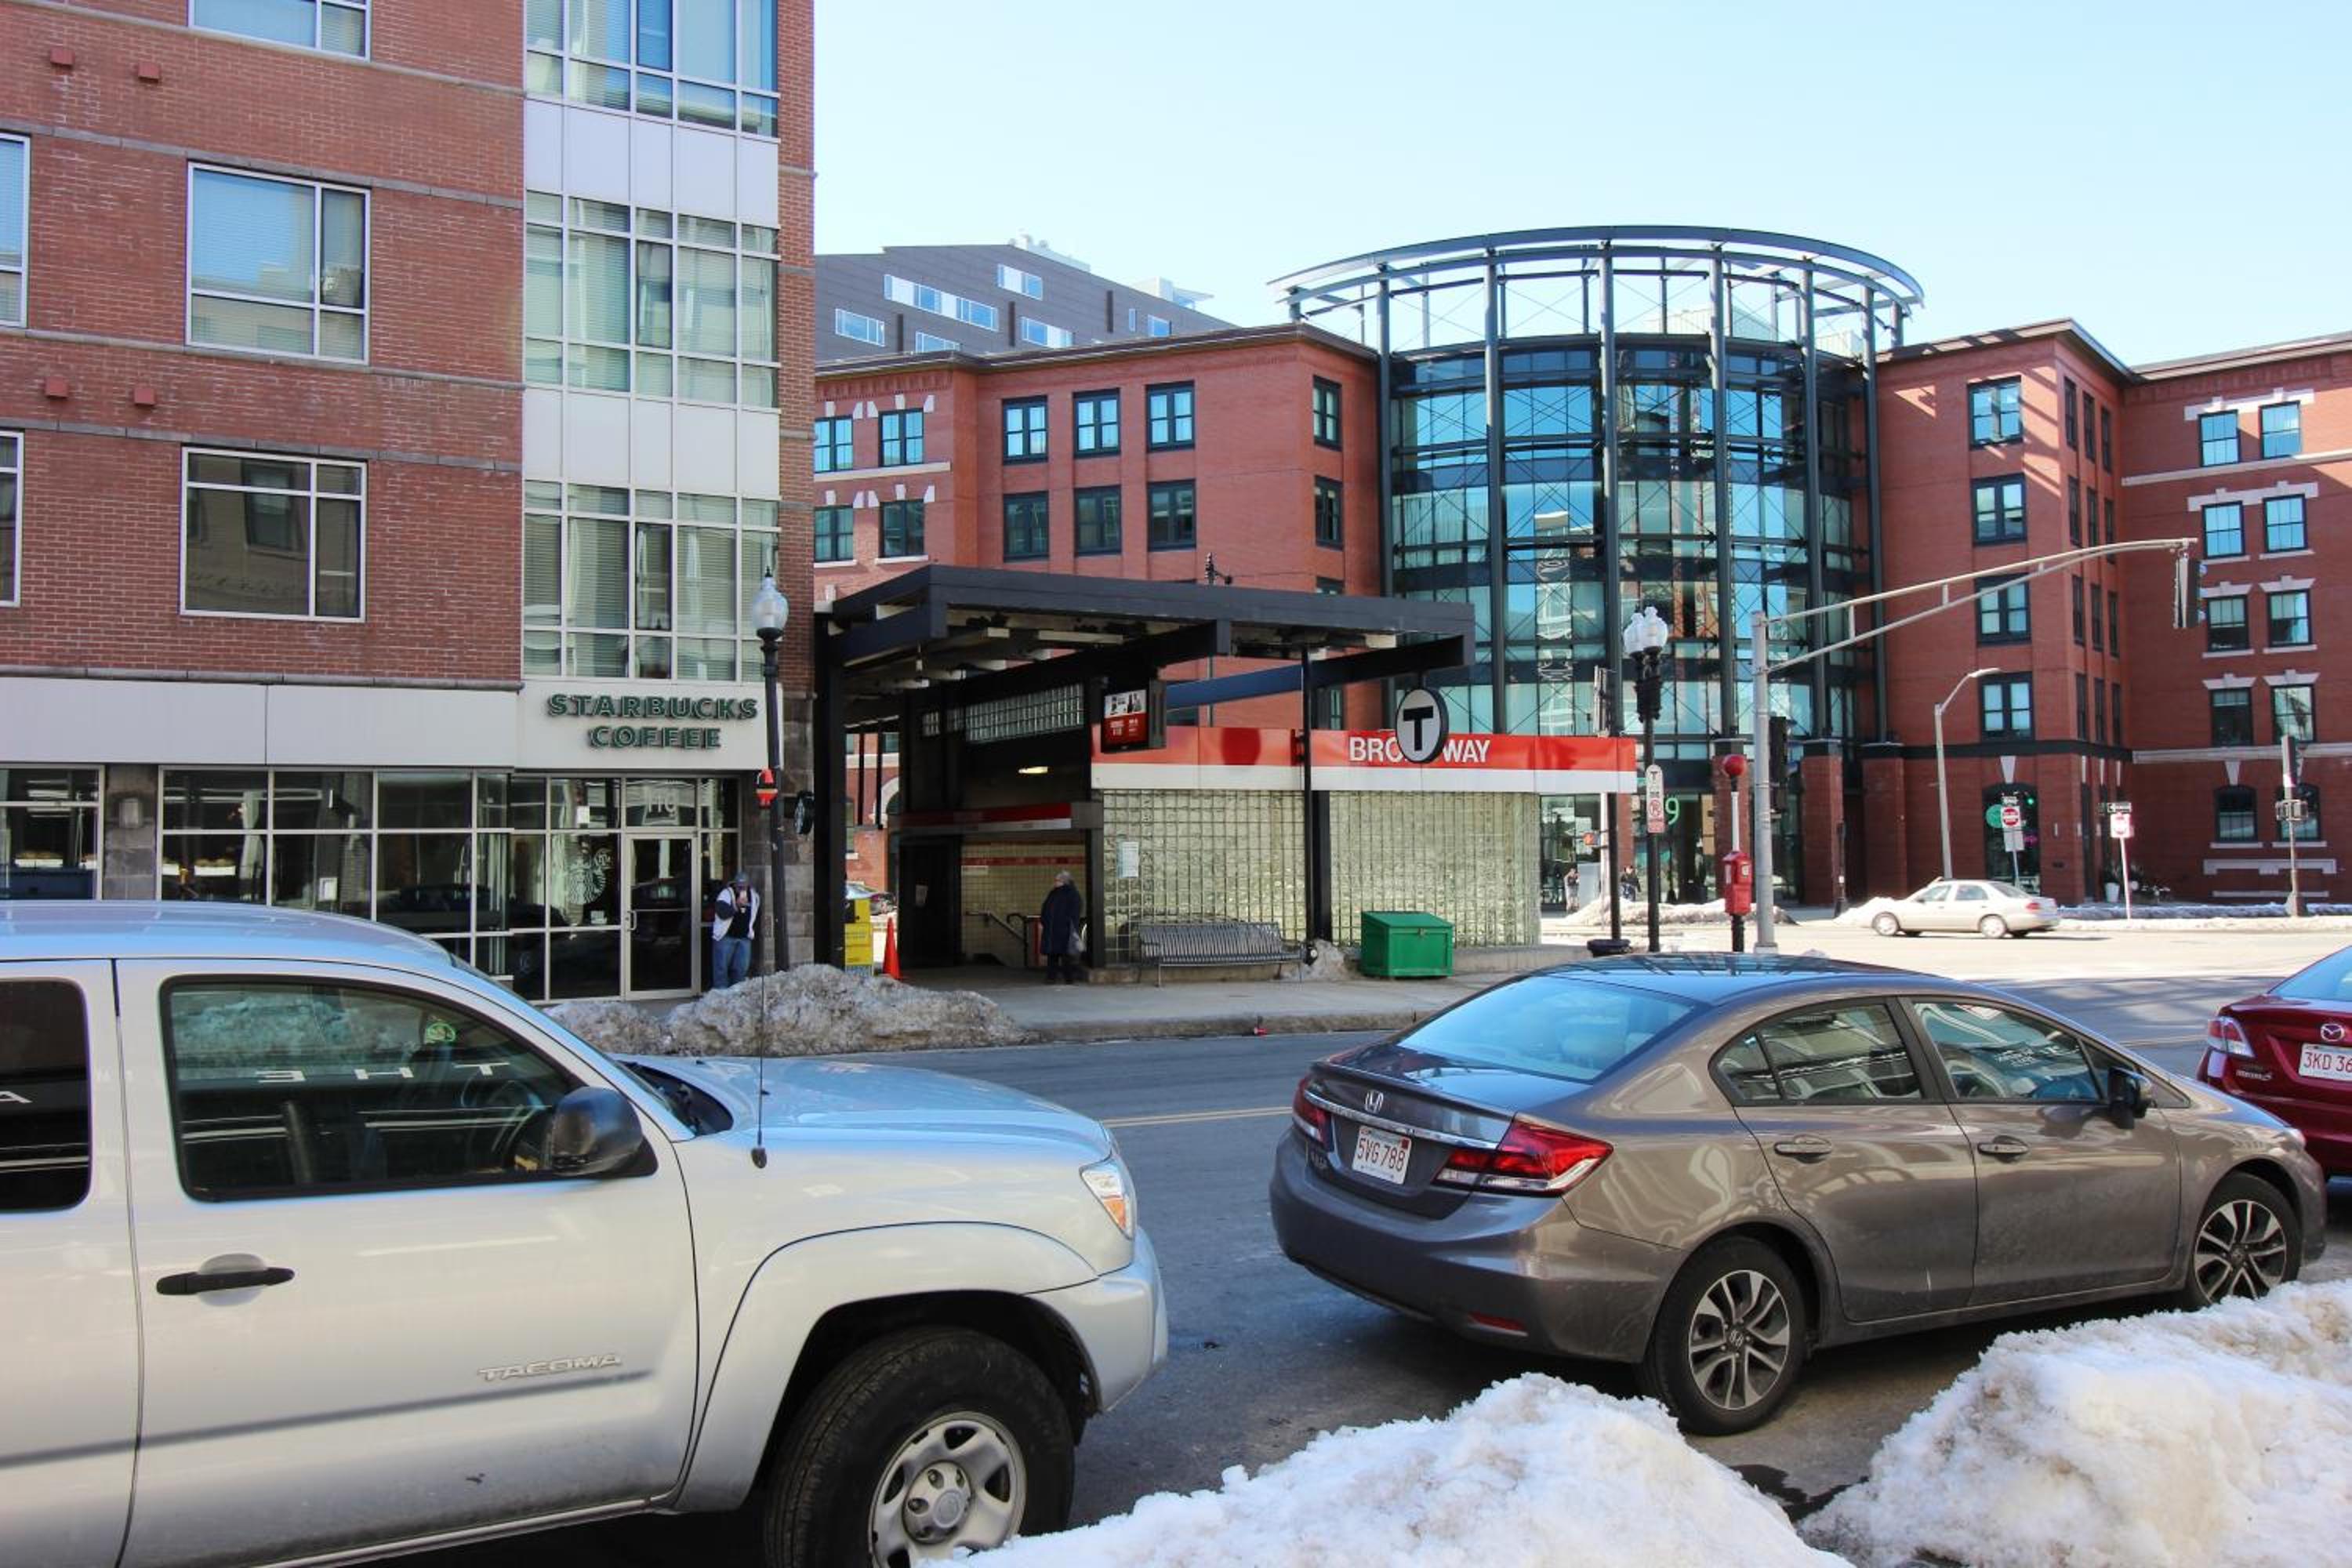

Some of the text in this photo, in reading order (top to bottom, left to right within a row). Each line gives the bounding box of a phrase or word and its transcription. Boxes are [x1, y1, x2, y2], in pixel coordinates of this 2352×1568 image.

[550, 694, 758, 720] STARBUCKS
[590, 726, 721, 750] COFFEE
[1403, 706, 1434, 751] T
[1348, 736, 1490, 764] BROWAY
[1664, 797, 1680, 826] 9
[2303, 1051, 2332, 1070] 3KD
[1357, 1138, 1381, 1164] 5VG
[1381, 1144, 1406, 1172] 788
[477, 1353, 622, 1381] TACOMA
